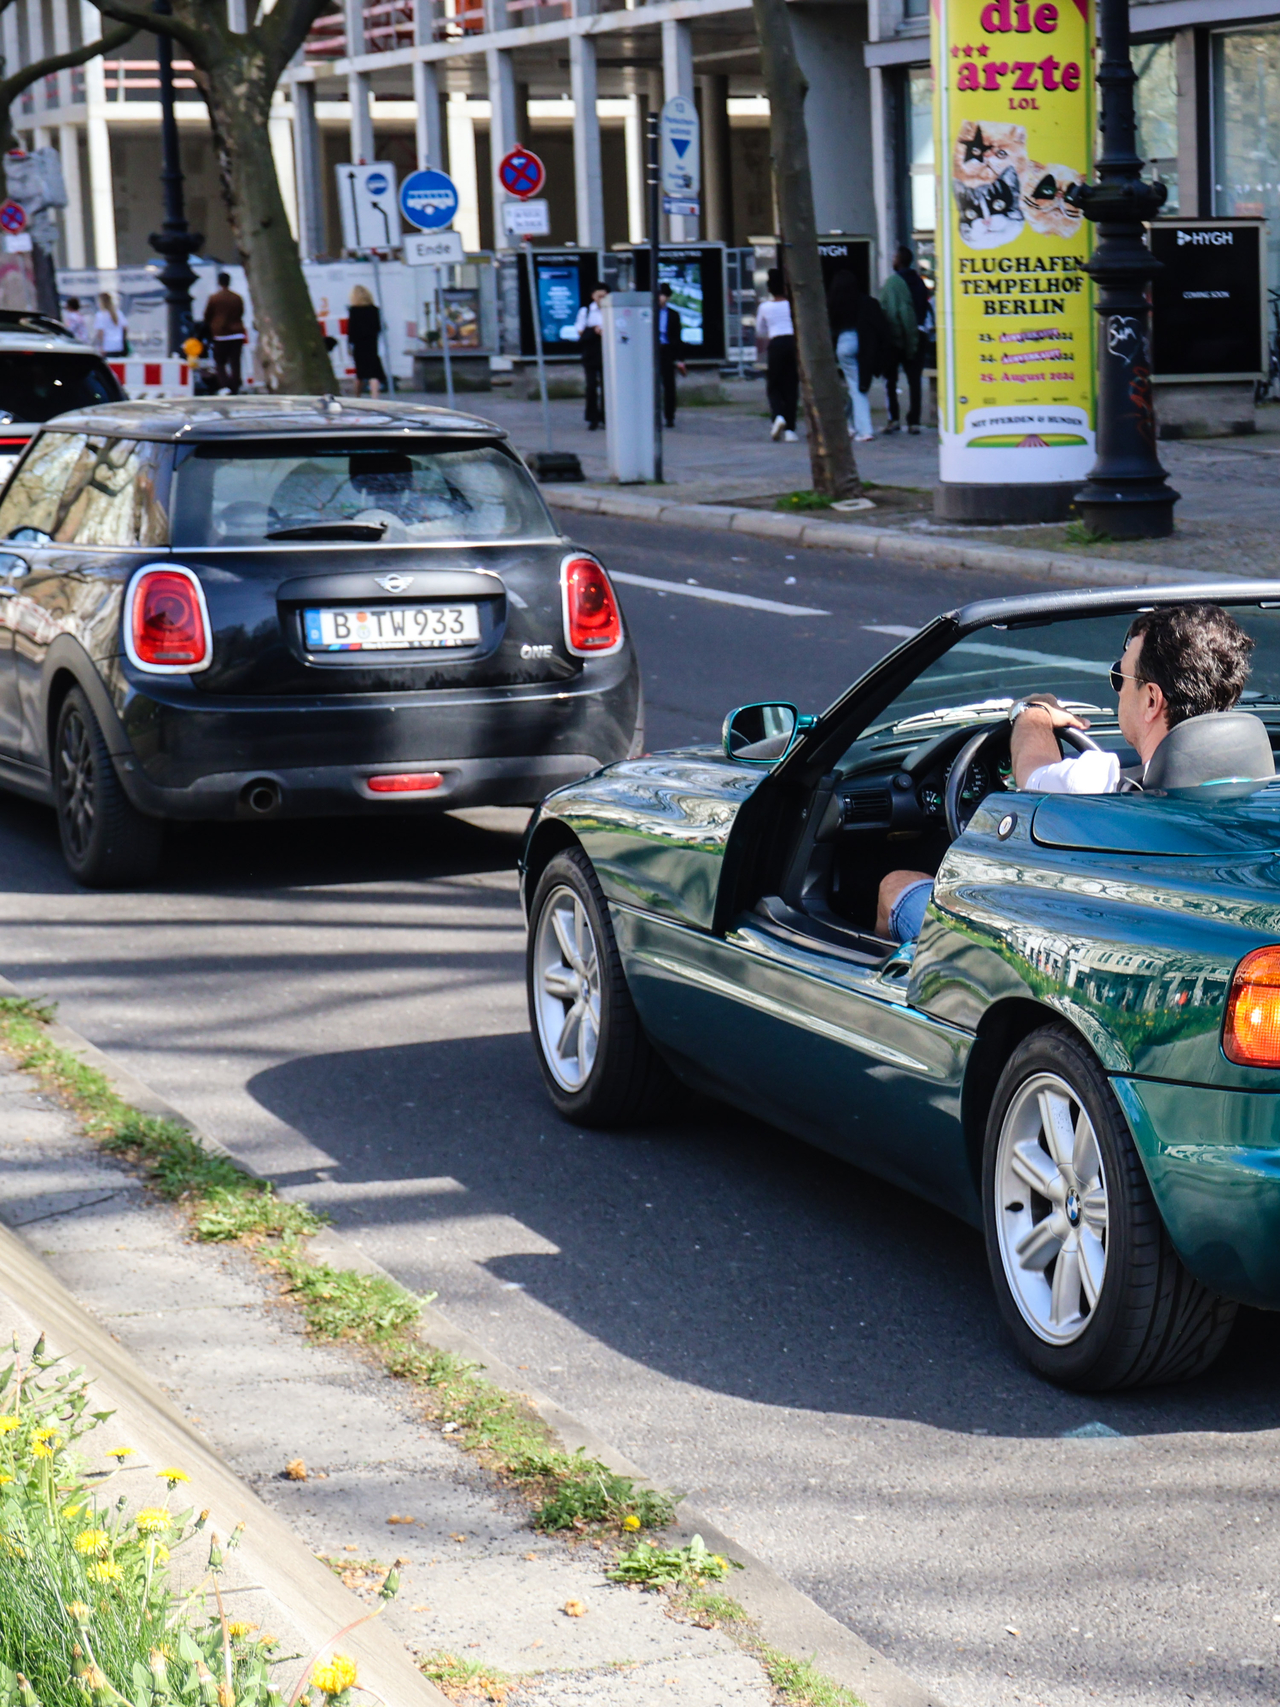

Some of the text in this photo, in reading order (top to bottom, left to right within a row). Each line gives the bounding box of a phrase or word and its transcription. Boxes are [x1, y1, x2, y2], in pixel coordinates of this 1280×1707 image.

[981, 0, 1059, 33] die
[1009, 98, 1039, 110] LOL
[1192, 231, 1234, 246] HYGH
[416, 243, 452, 257] Ende
[958, 256, 1084, 275] FLUGHAFEN
[961, 277, 1084, 296] TEMPELHOF
[983, 298, 1065, 316] BERLIN
[1001, 372, 1046, 384] August
[1049, 372, 1075, 382] 2024
[971, 419, 987, 428] MIT
[989, 416, 1035, 426] PFERDEN
[1047, 416, 1083, 426] HUNDEN
[333, 614, 351, 639] B
[370, 611, 406, 638] TW
[414, 609, 465, 635] 933
[520, 644, 554, 660] ONE
